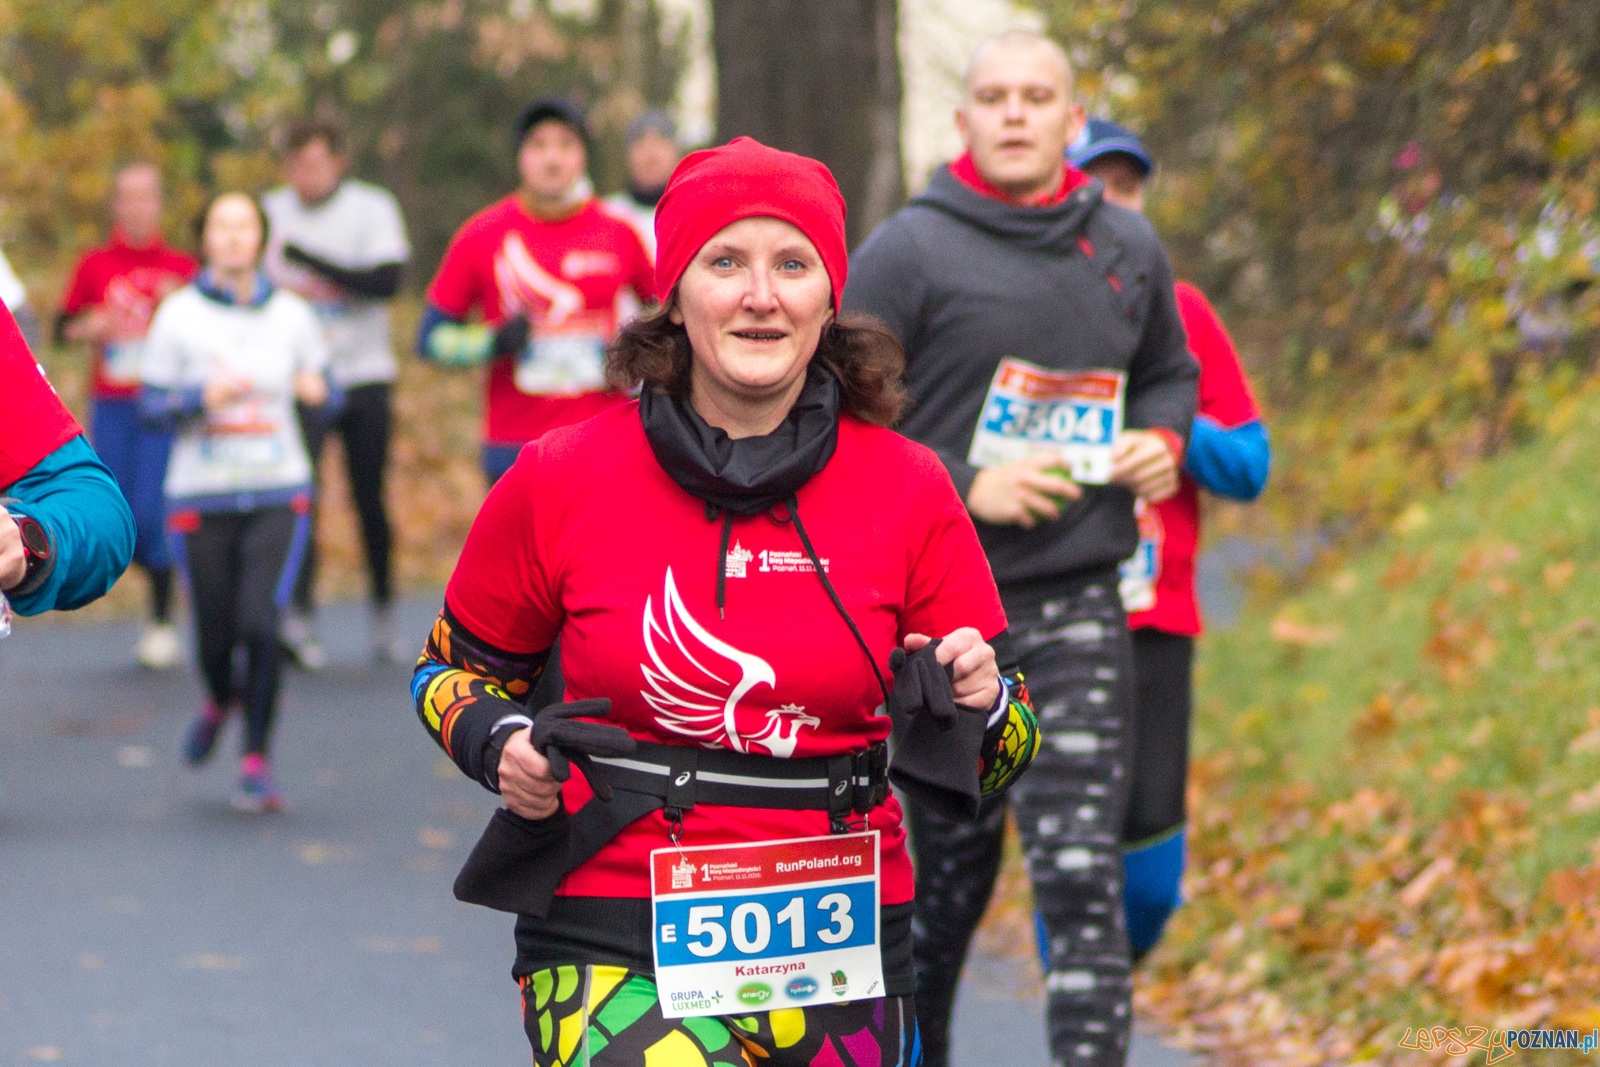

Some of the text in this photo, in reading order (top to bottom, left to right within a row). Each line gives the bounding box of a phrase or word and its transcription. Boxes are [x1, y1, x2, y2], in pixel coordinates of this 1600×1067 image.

[758, 549, 770, 572] 1
[776, 854, 862, 873] RunPoland.org
[701, 863, 711, 882] 1
[661, 892, 854, 957] E 5013
[735, 961, 806, 976] Katarzyna
[670, 990, 704, 1001] GRUPA
[742, 990, 769, 1000] energy
[672, 1000, 711, 1010] LUXMED
